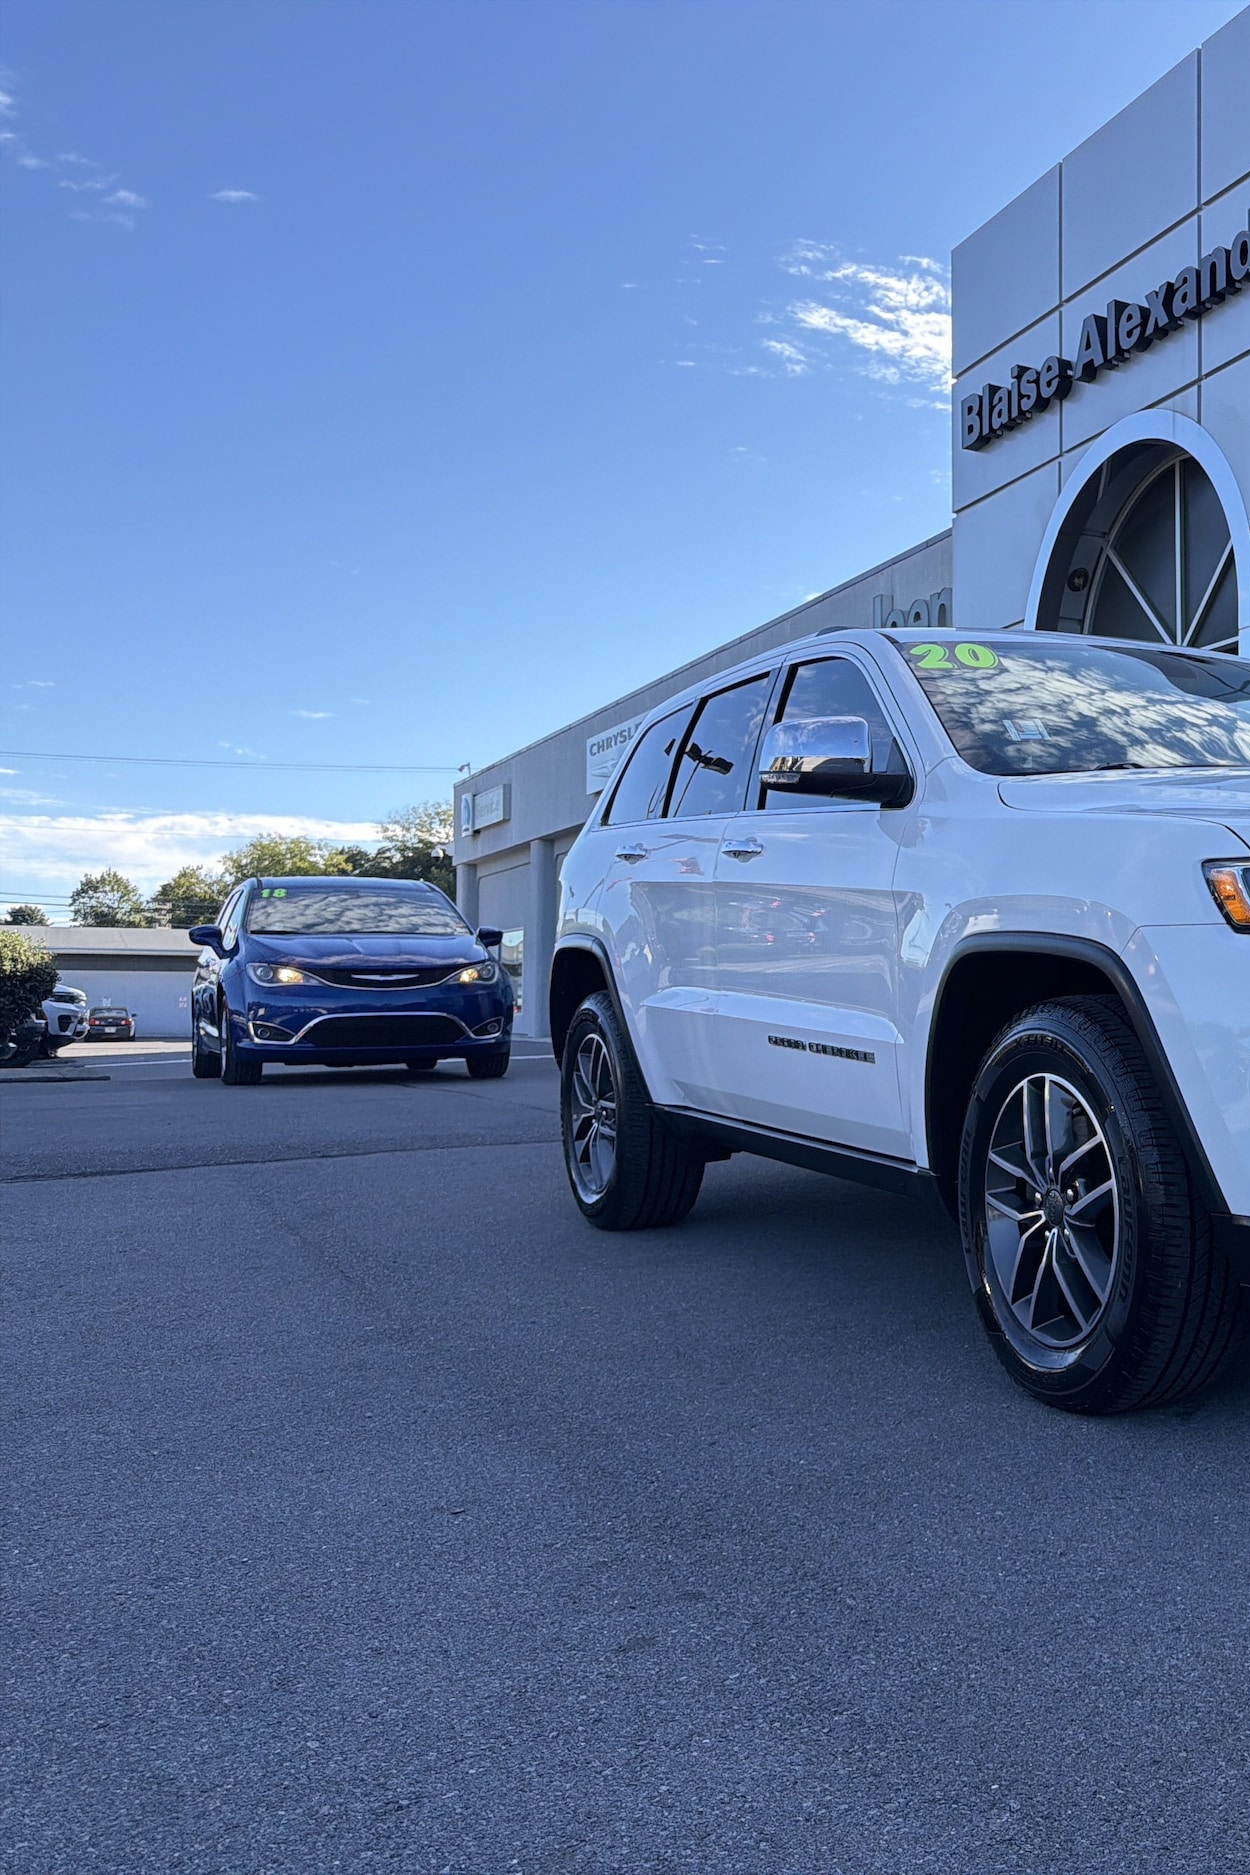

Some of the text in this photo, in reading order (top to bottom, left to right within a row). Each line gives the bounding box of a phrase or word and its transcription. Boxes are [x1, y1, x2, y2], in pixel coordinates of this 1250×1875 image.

[961, 355, 1073, 452] Blaise
[909, 642, 999, 669] 20
[260, 888, 288, 899] 18
[808, 1041, 876, 1065] CHEROKEE
